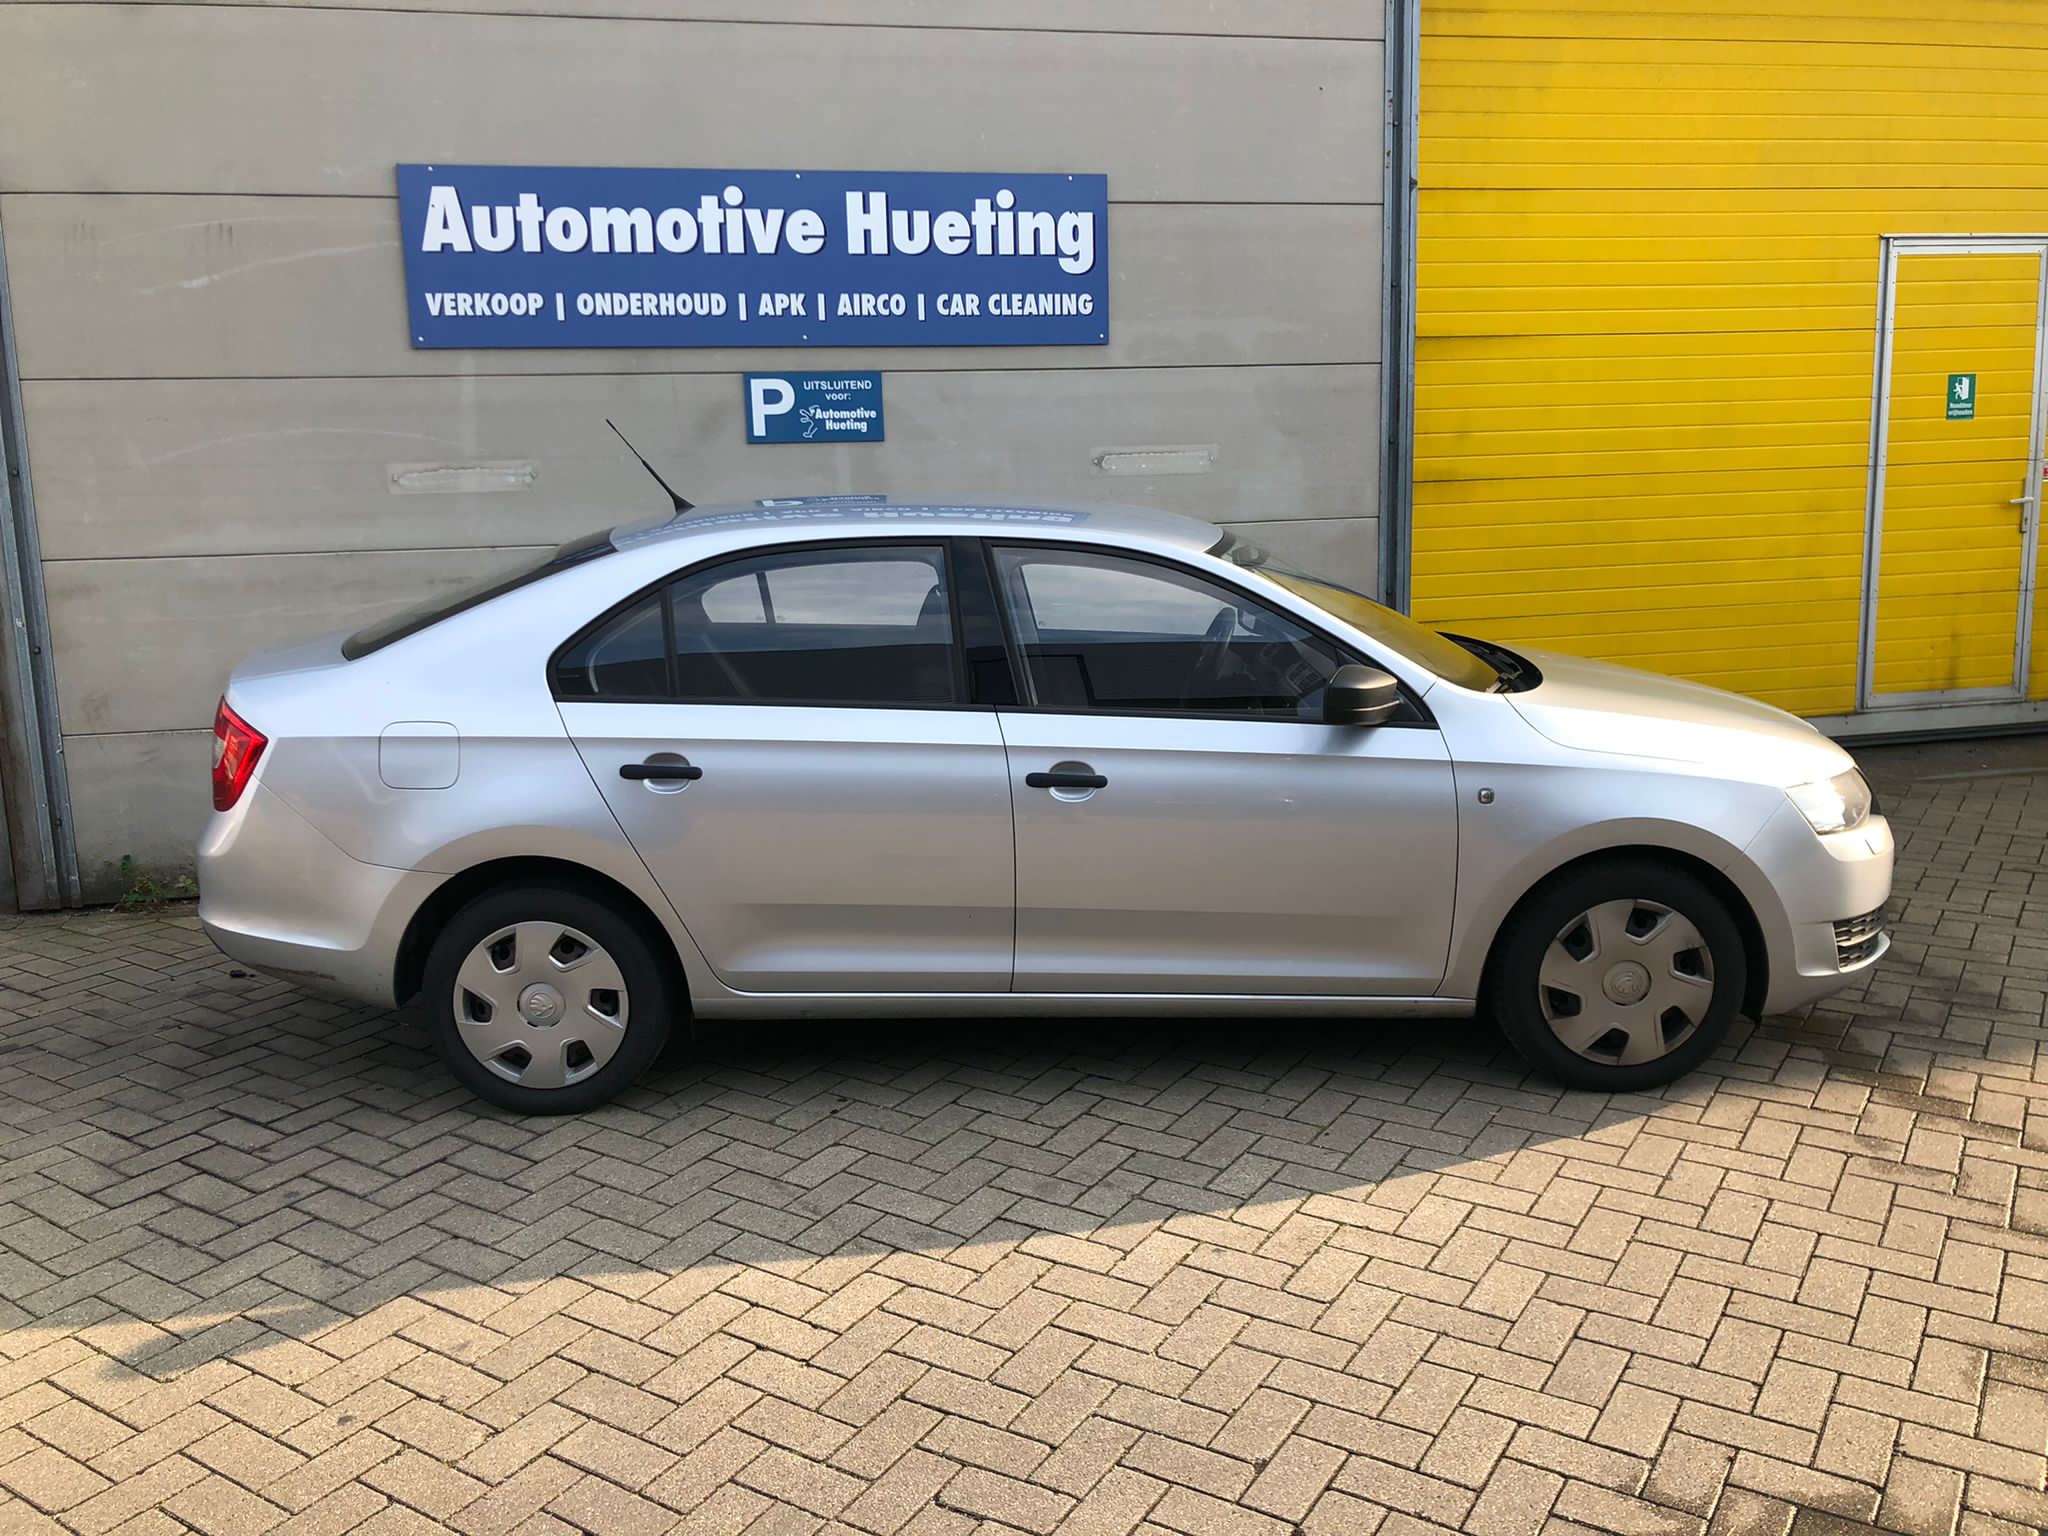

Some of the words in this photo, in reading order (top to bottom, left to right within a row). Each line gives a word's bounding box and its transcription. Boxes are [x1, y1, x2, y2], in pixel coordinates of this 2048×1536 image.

[421, 185, 826, 254] Automotive
[845, 188, 1095, 275] Hueting
[424, 292, 545, 317] VERKOOP
[576, 292, 727, 317] ONDERHOUD
[758, 292, 807, 317] APK
[837, 292, 906, 317] AIRCO
[936, 292, 981, 317] CAR
[987, 292, 1094, 317] CLEANING
[803, 380, 872, 390] UITSLUITEND
[825, 392, 852, 401] voor:
[750, 378, 796, 437] P
[815, 407, 877, 419] Automotive
[825, 419, 868, 433] Hueting
